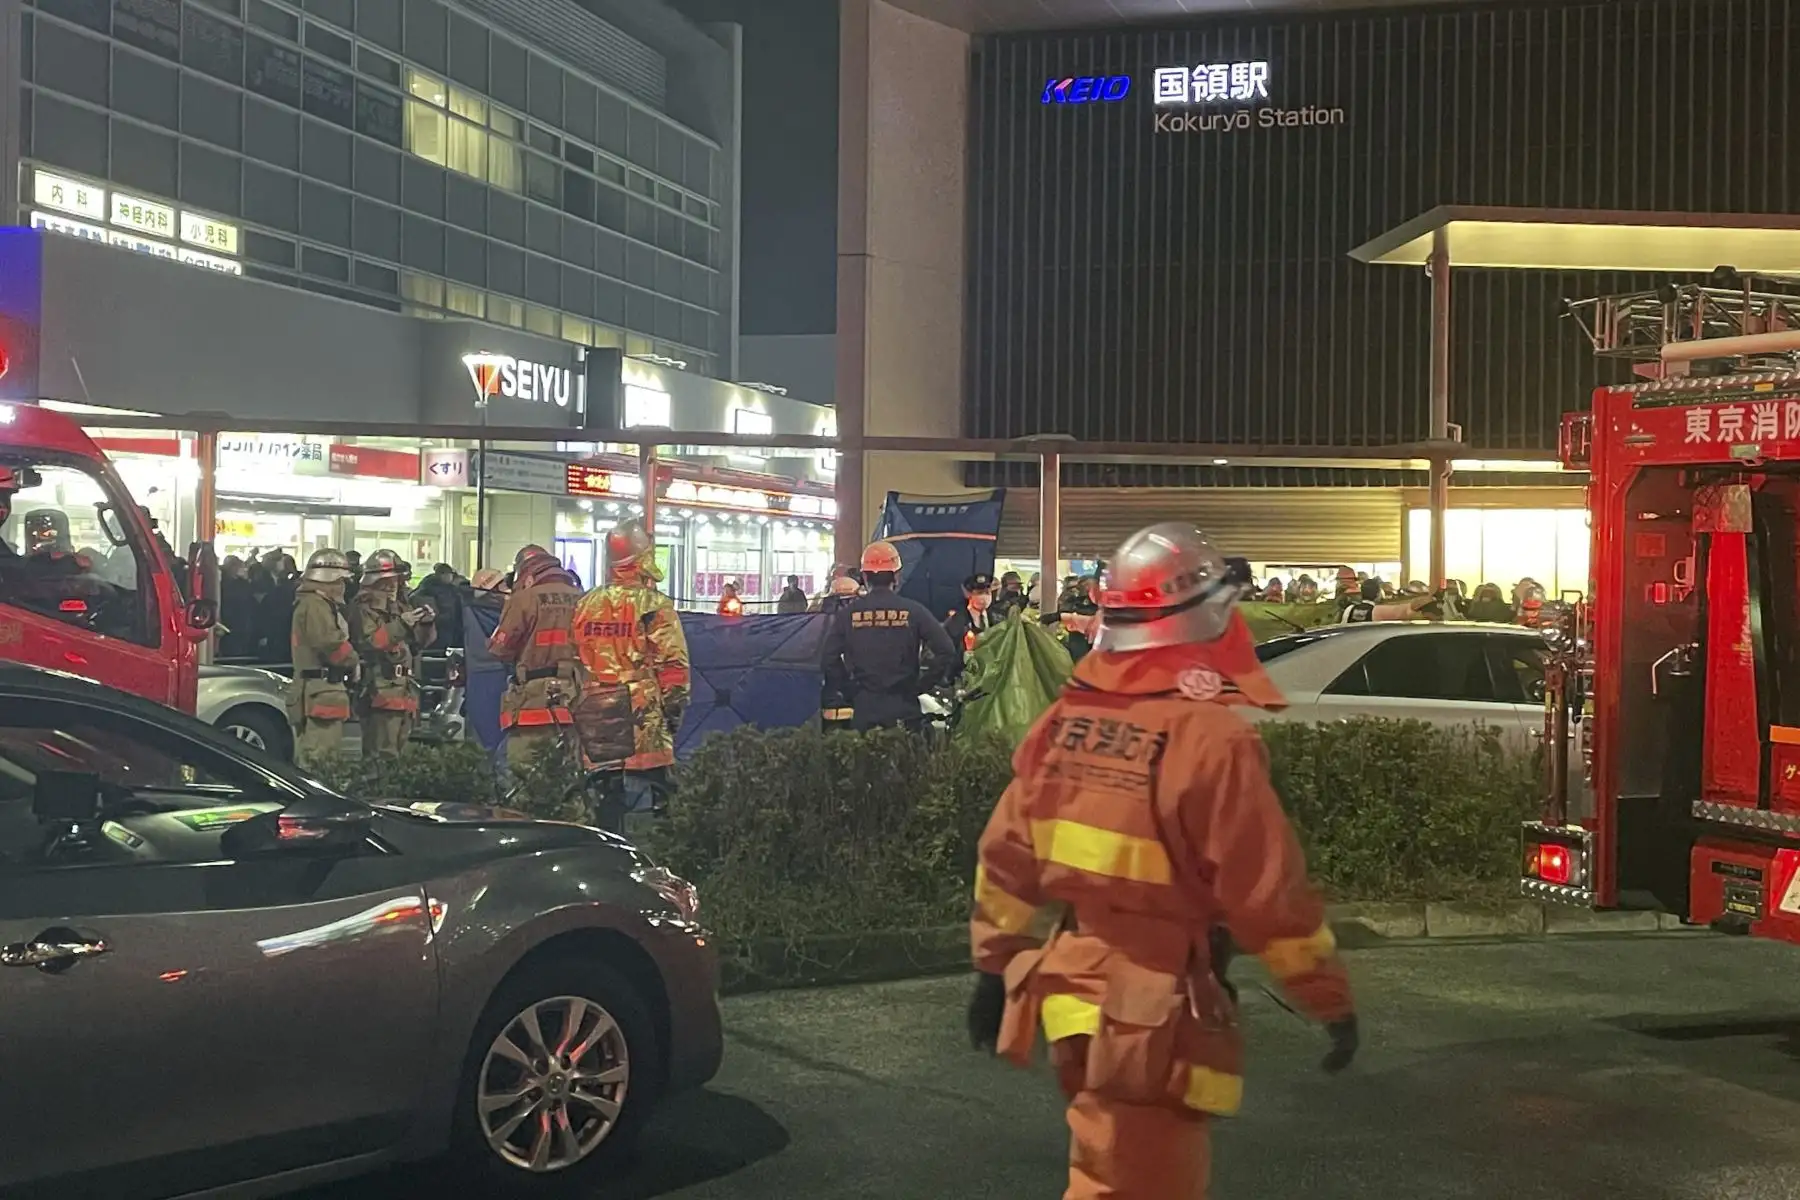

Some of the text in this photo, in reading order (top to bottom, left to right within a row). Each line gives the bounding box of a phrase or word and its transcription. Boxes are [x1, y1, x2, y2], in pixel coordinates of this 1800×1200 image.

[1041, 76, 1130, 104] KEIO
[1154, 61, 1269, 104] 国領駅
[1154, 105, 1344, 133] Kokuryō Station
[500, 356, 570, 407] SEIYU
[429, 461, 462, 475] くすり
